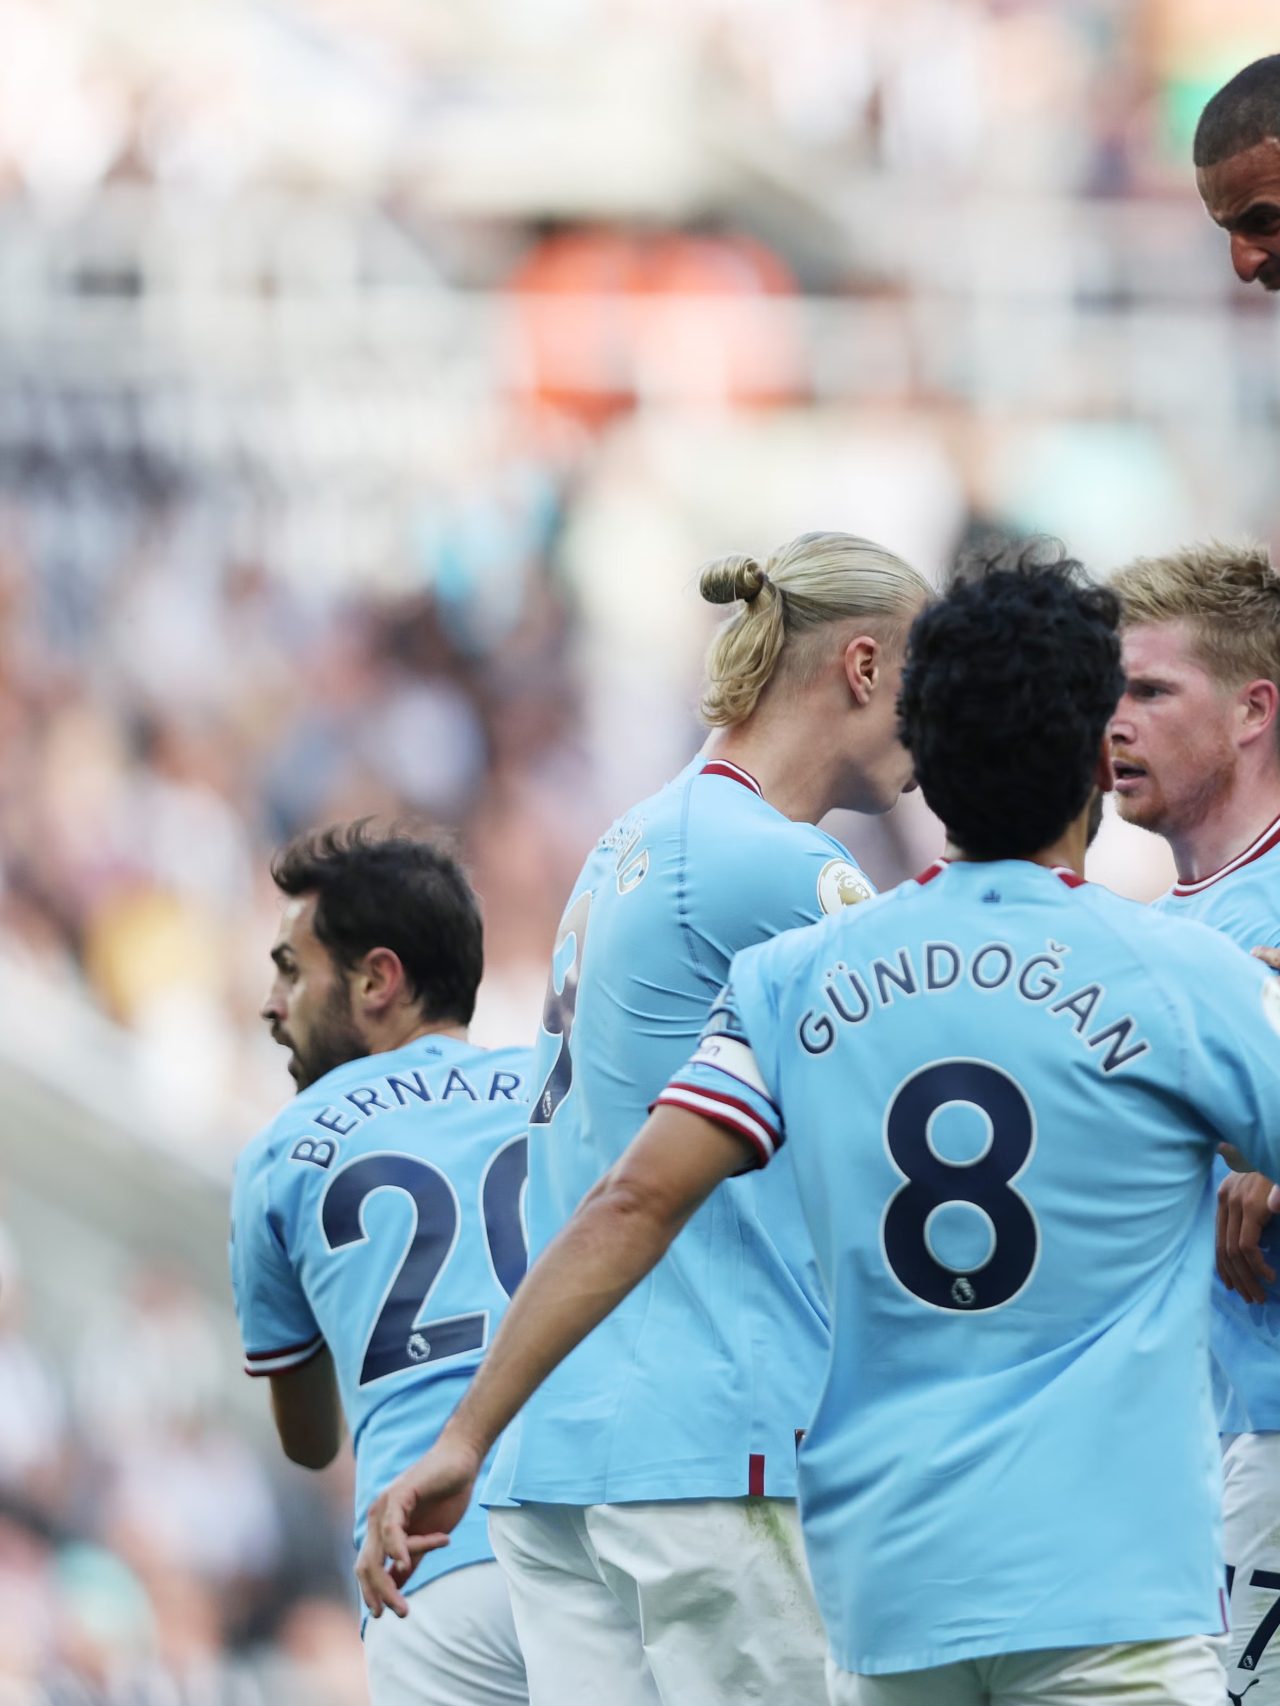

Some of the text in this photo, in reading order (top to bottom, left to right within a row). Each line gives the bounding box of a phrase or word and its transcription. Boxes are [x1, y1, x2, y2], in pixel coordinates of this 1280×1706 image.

[798, 938, 1148, 1073] GÜNDOĞAN
[290, 1066, 530, 1170] BERNAR
[880, 1056, 1041, 1315] 8
